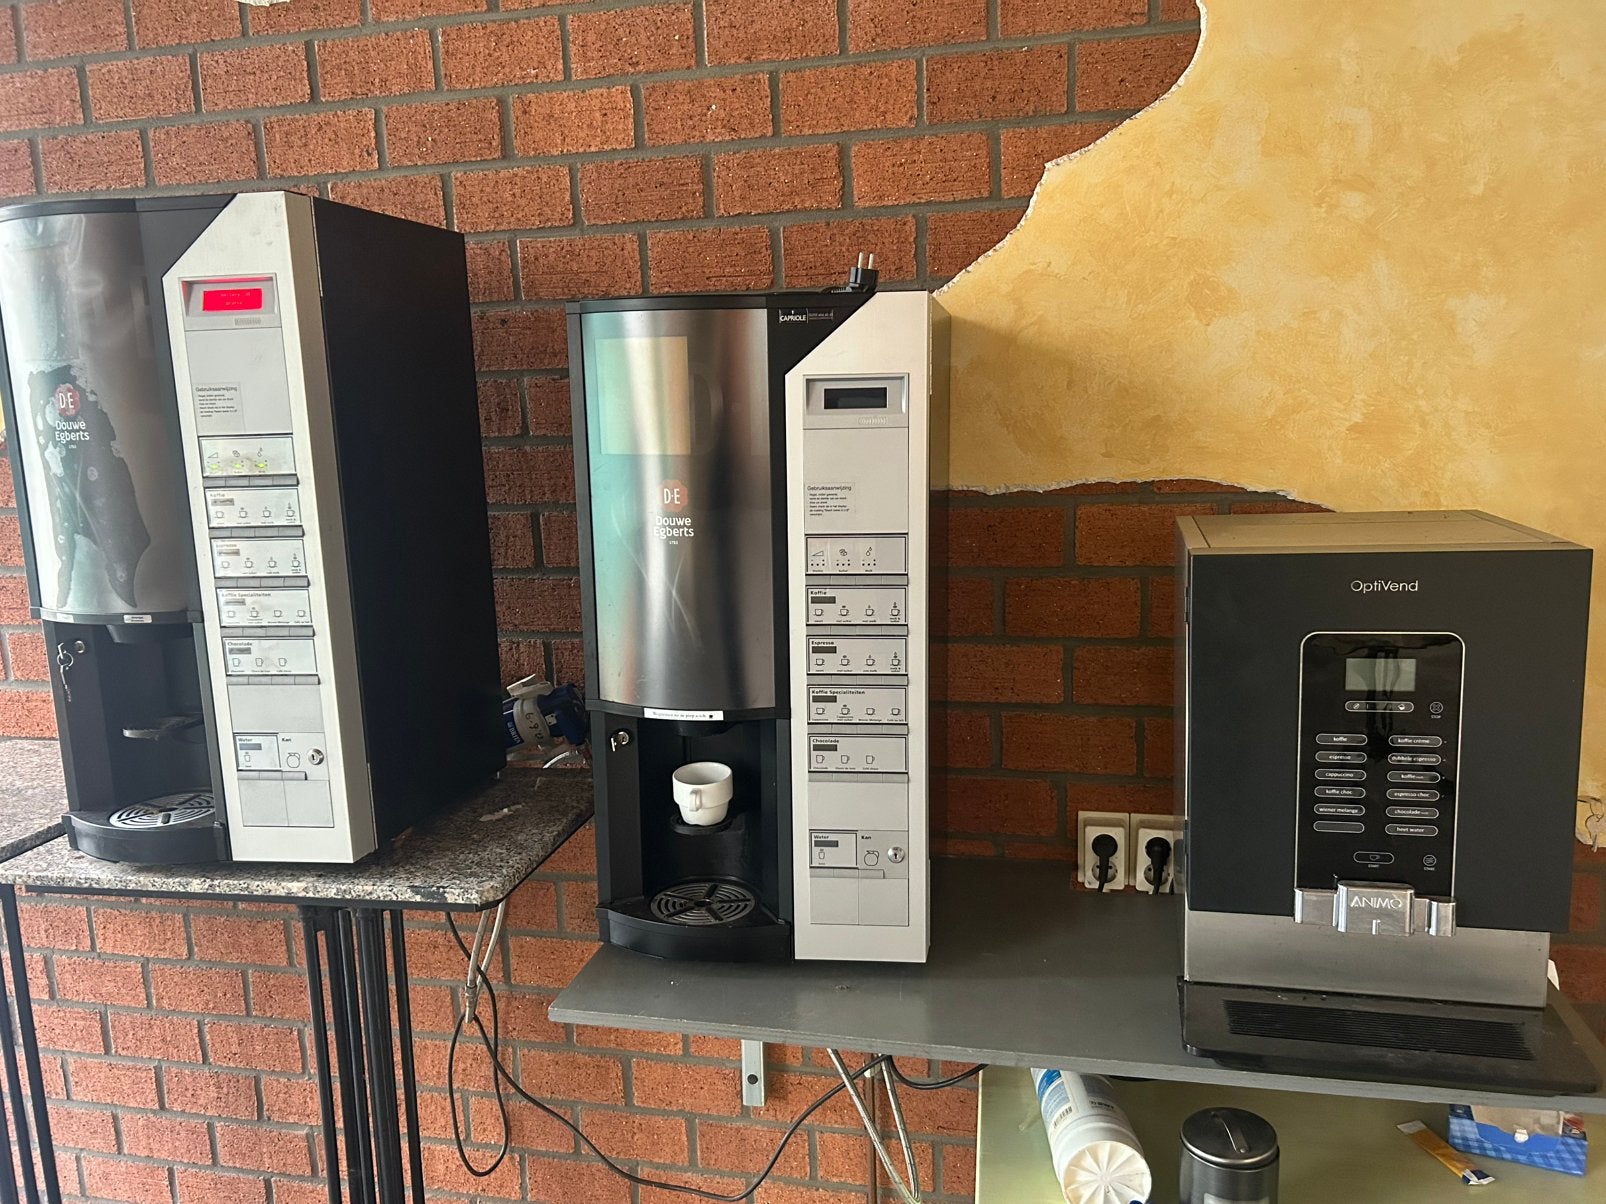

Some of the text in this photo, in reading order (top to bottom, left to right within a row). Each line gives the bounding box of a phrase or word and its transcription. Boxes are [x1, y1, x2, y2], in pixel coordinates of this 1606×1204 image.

[779, 314, 807, 322] CAPRIOLE
[55, 420, 87, 430] Douwe
[55, 430, 90, 444] Egberts
[655, 516, 692, 526] Douwe
[653, 527, 695, 540] Egberts
[1350, 580, 1419, 594] OptiVend
[1350, 895, 1403, 909] ANIMO
